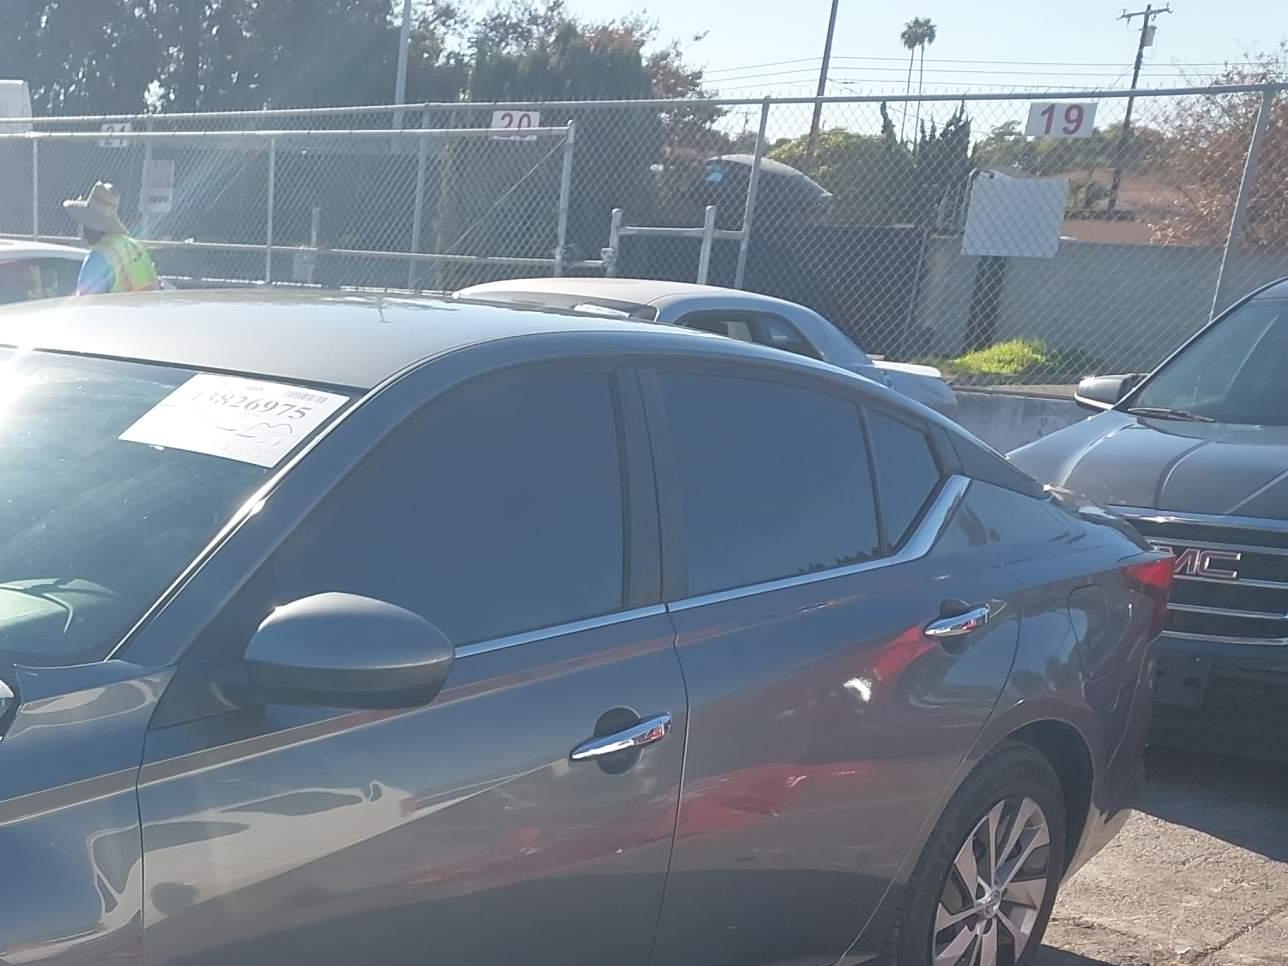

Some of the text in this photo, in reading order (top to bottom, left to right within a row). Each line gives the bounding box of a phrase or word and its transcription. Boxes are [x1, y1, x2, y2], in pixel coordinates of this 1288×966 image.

[500, 112, 531, 138] 20
[1040, 103, 1084, 135] 19
[191, 391, 313, 420] 3826975
[1151, 545, 1242, 579] MC
